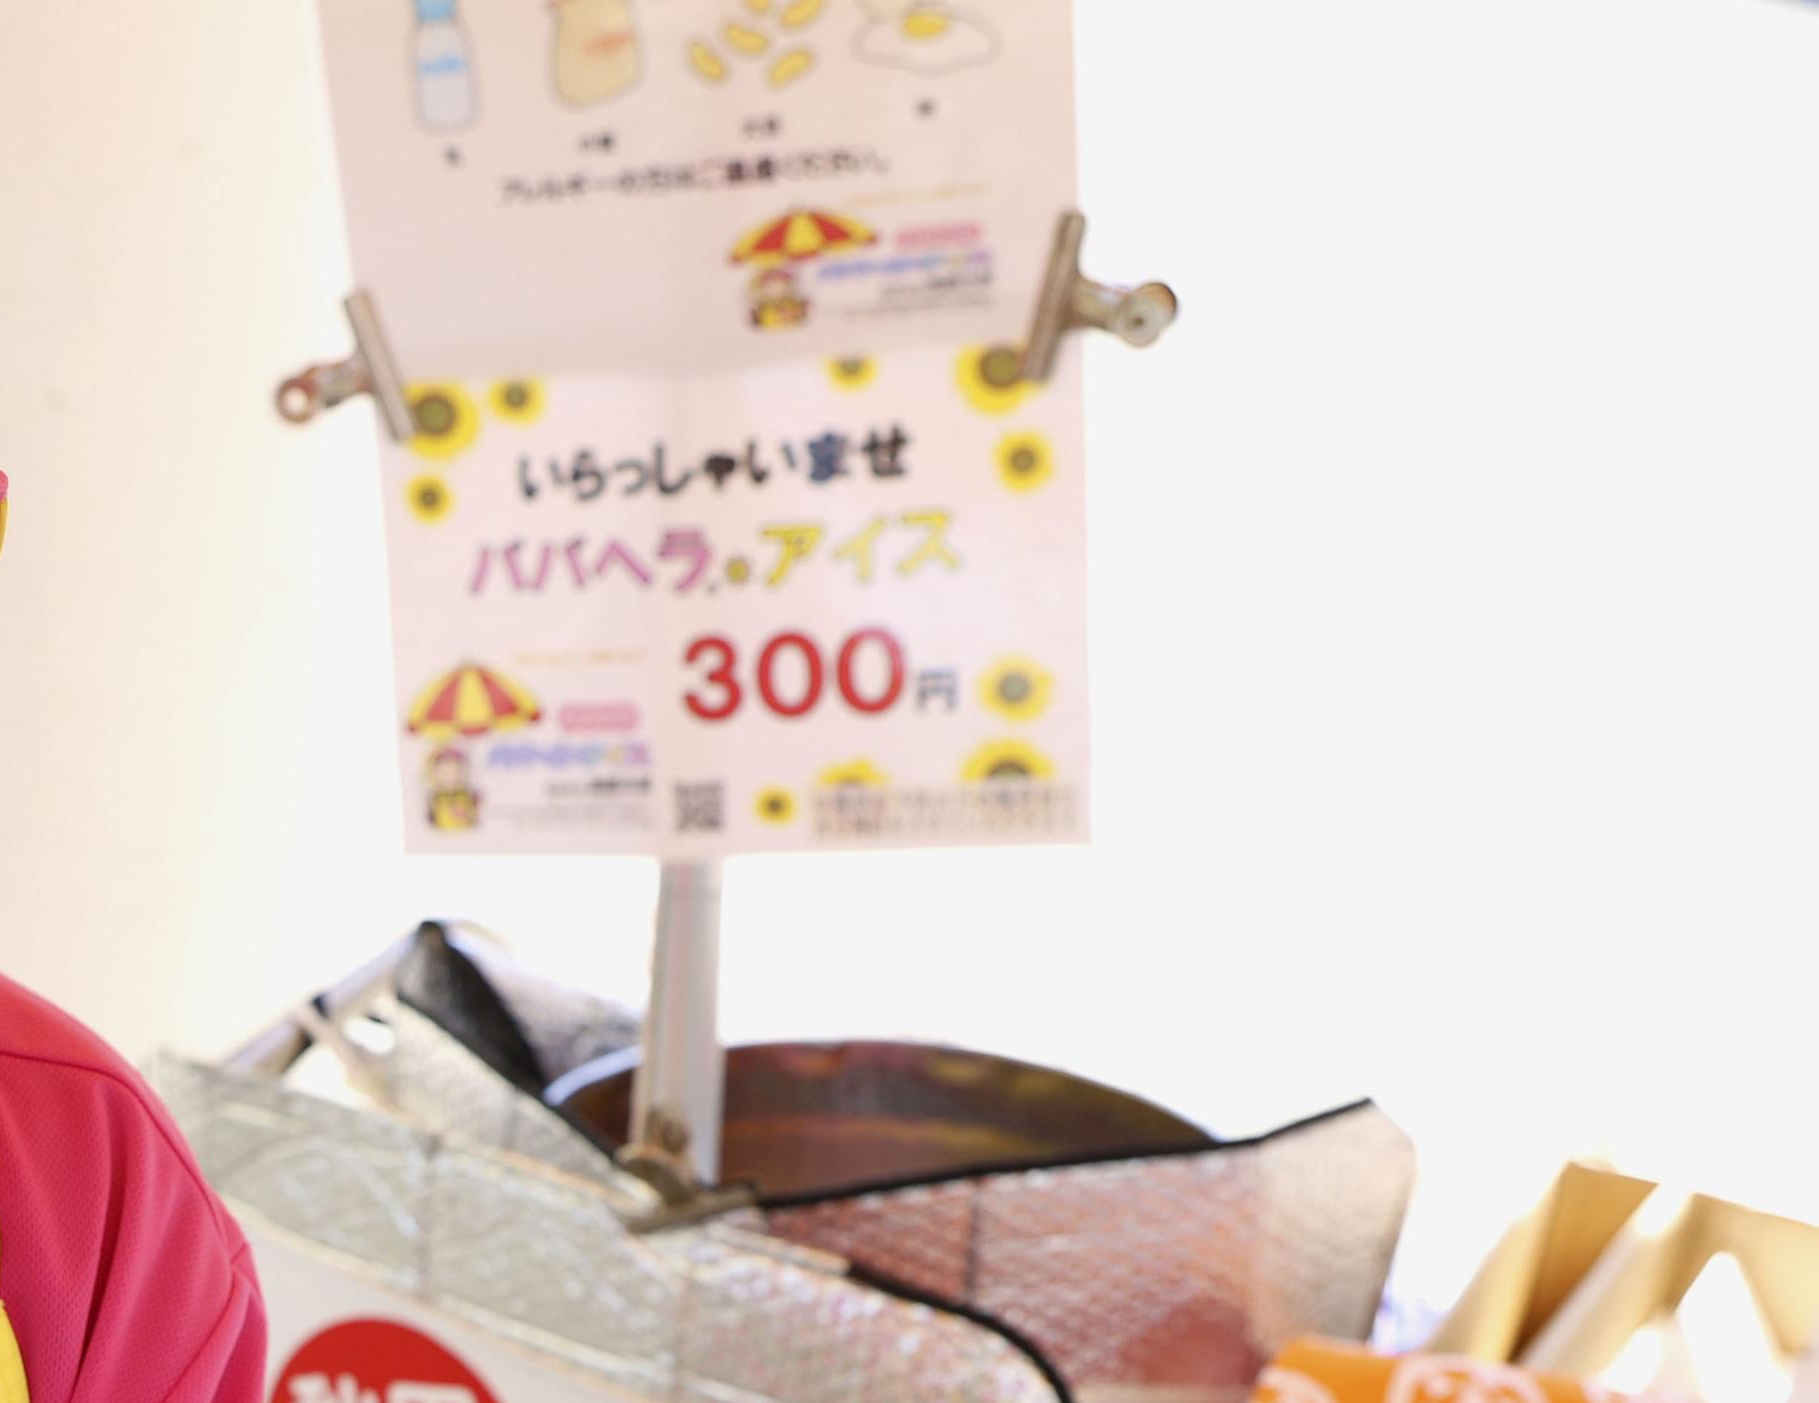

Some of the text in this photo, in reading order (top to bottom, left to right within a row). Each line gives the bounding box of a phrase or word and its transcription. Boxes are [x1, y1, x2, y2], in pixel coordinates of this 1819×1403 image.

[517, 426, 912, 502] いらっしゃいませ
[682, 625, 958, 723] 300円
